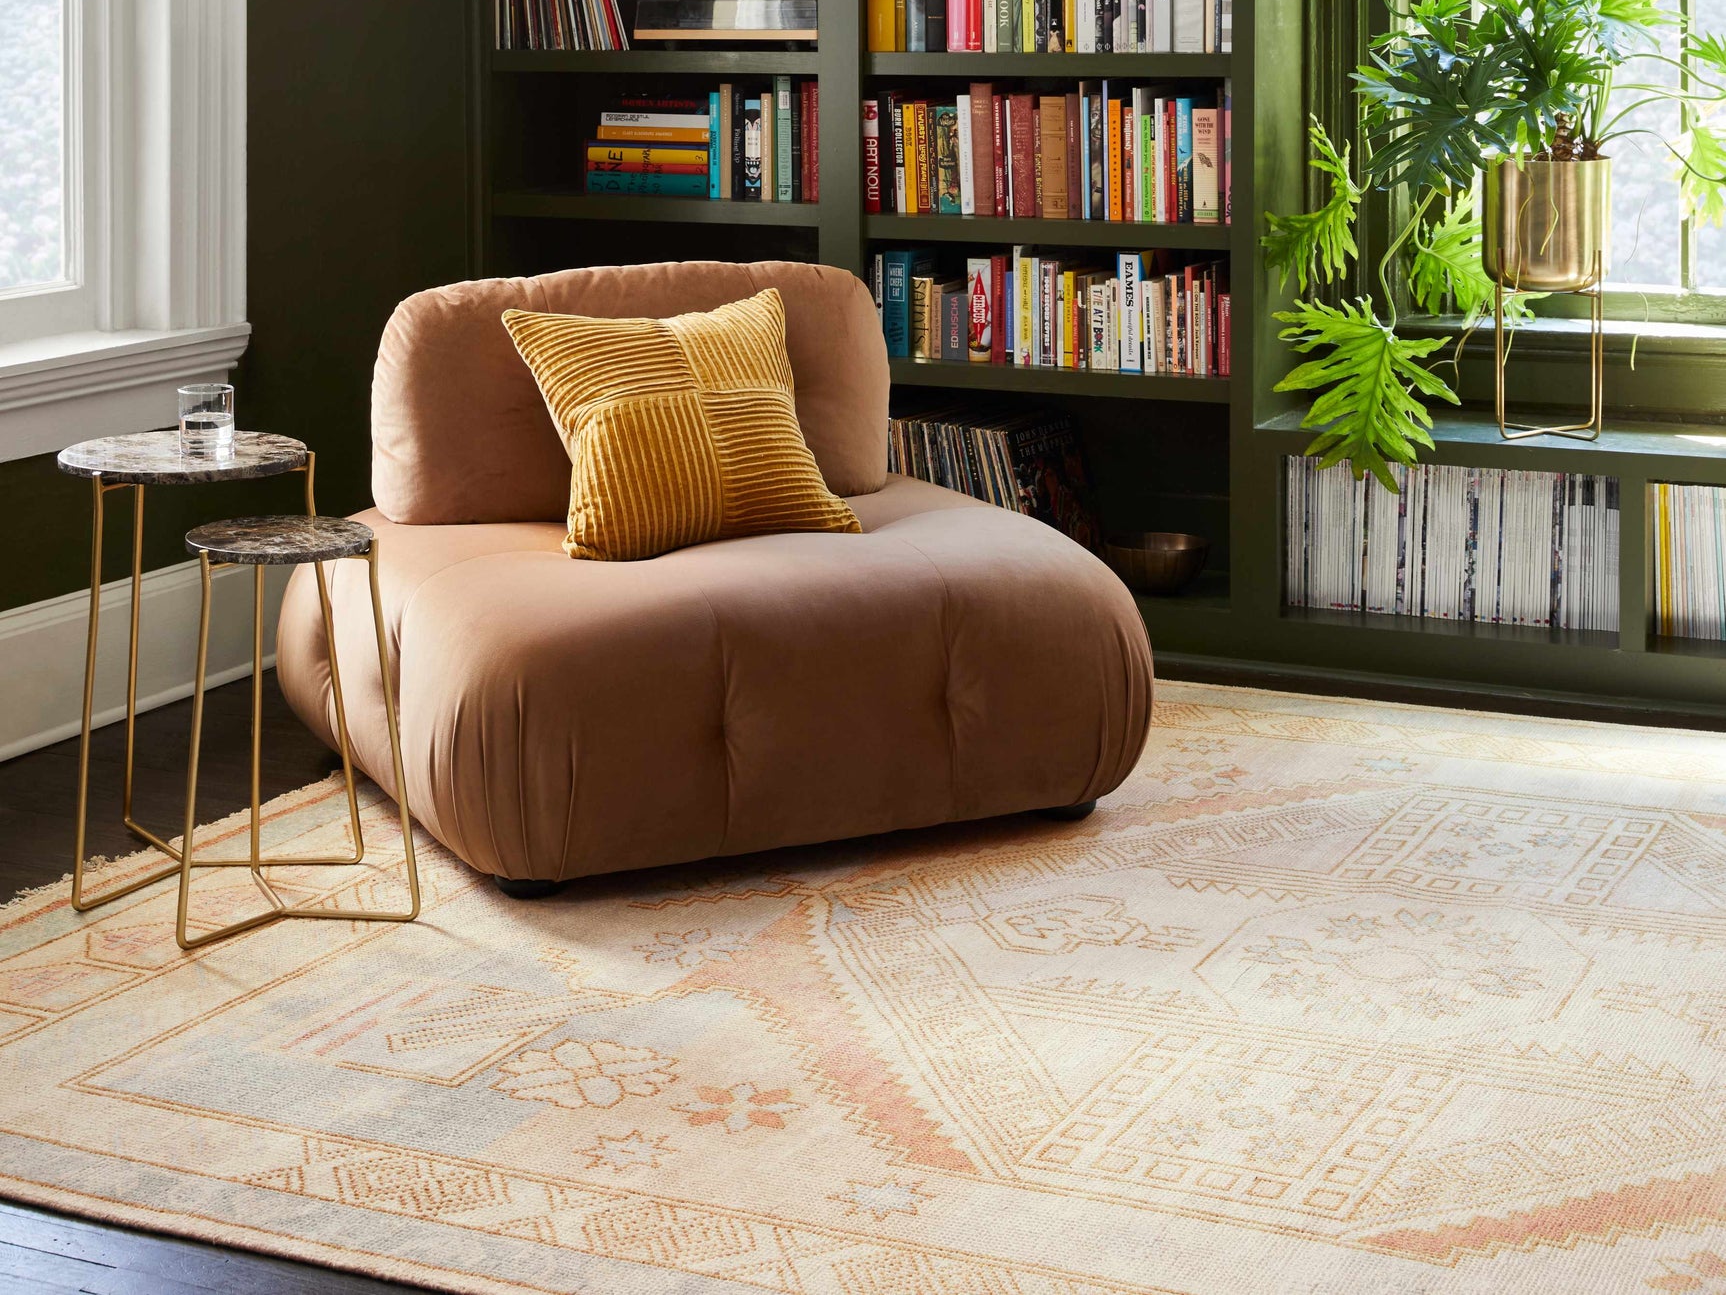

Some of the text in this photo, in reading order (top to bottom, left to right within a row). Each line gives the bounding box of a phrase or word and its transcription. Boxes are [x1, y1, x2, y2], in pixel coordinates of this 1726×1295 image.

[895, 128, 903, 164] COLLECTOR
[866, 138, 879, 200] ART NOW
[1125, 261, 1134, 307] EAMES
[972, 294, 985, 324] CIRCUS
